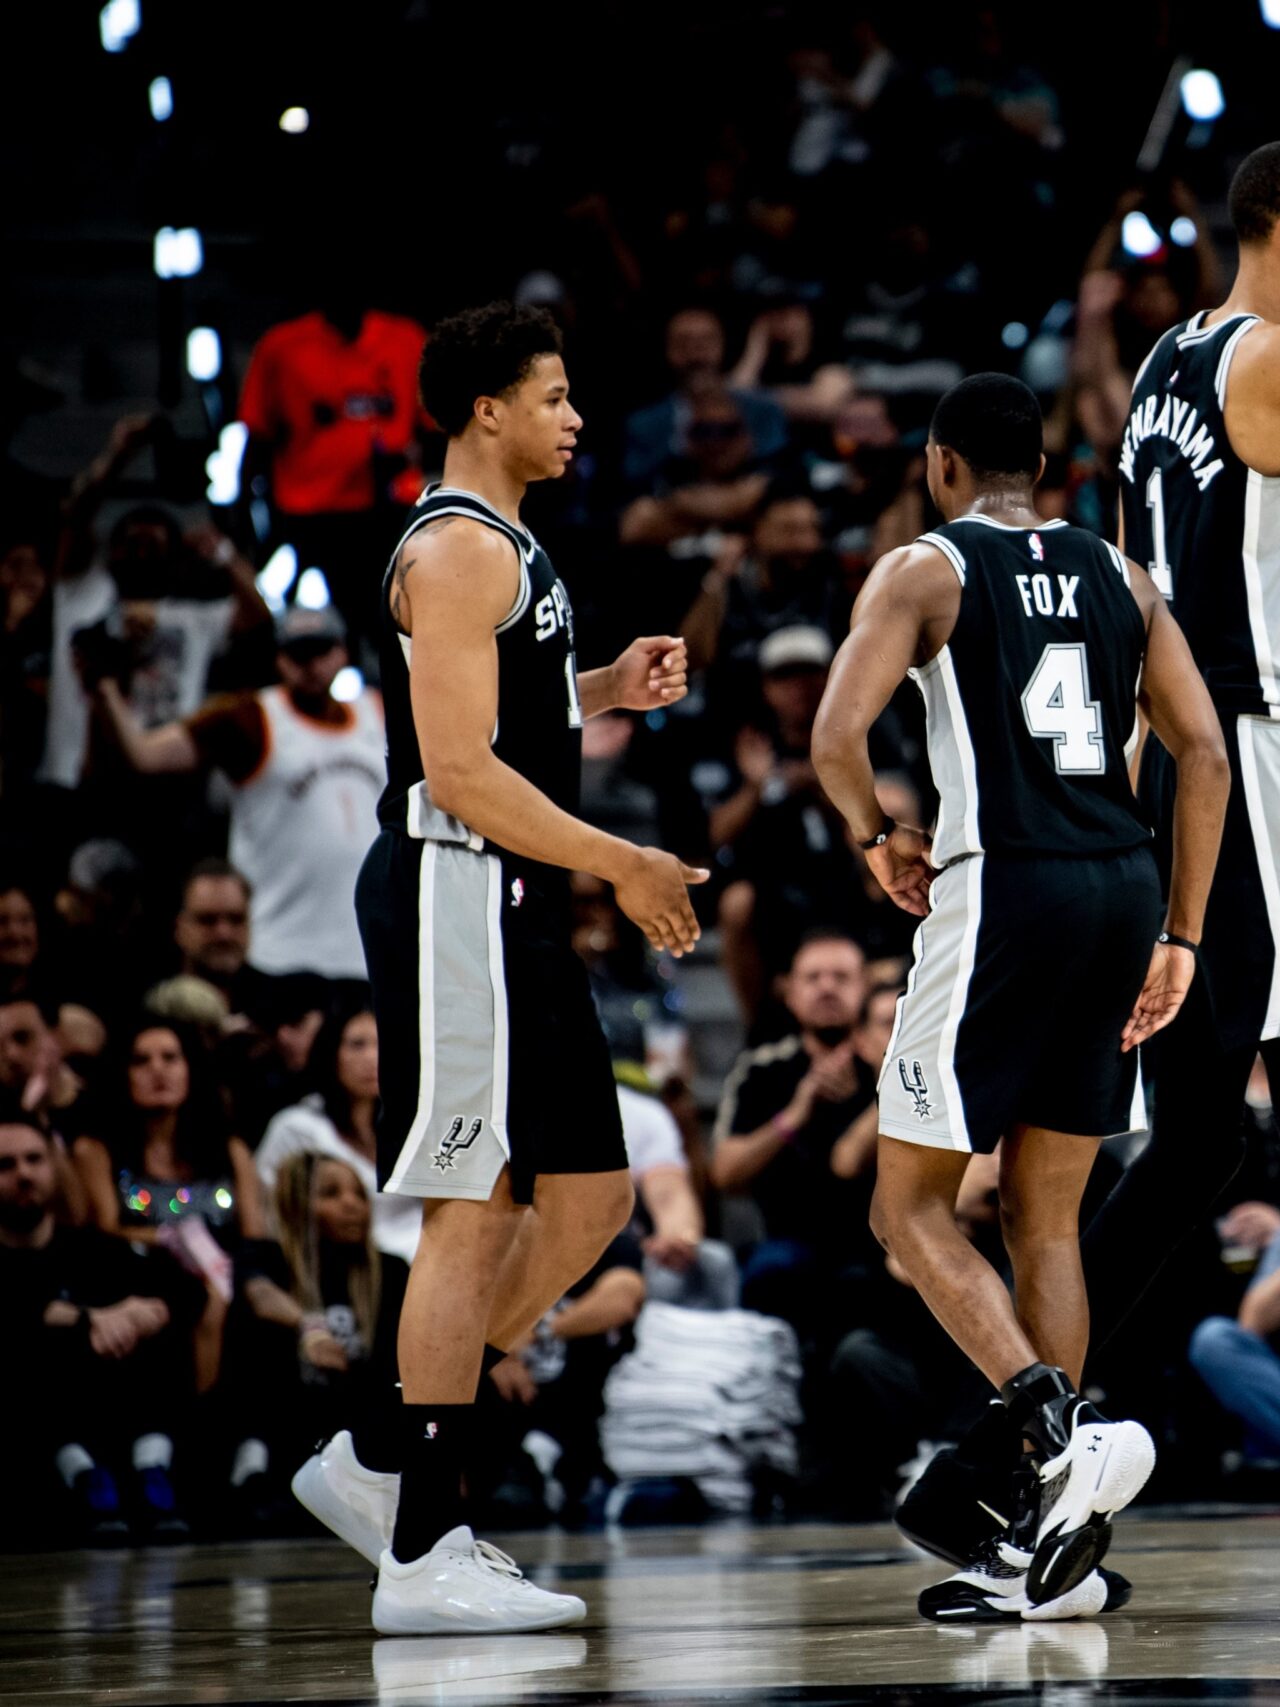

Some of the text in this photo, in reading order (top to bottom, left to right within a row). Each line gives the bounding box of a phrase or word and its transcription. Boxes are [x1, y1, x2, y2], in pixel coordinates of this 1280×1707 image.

[1015, 574, 1080, 618] FOX
[1146, 467, 1173, 600] 1
[1020, 642, 1106, 775] 4
